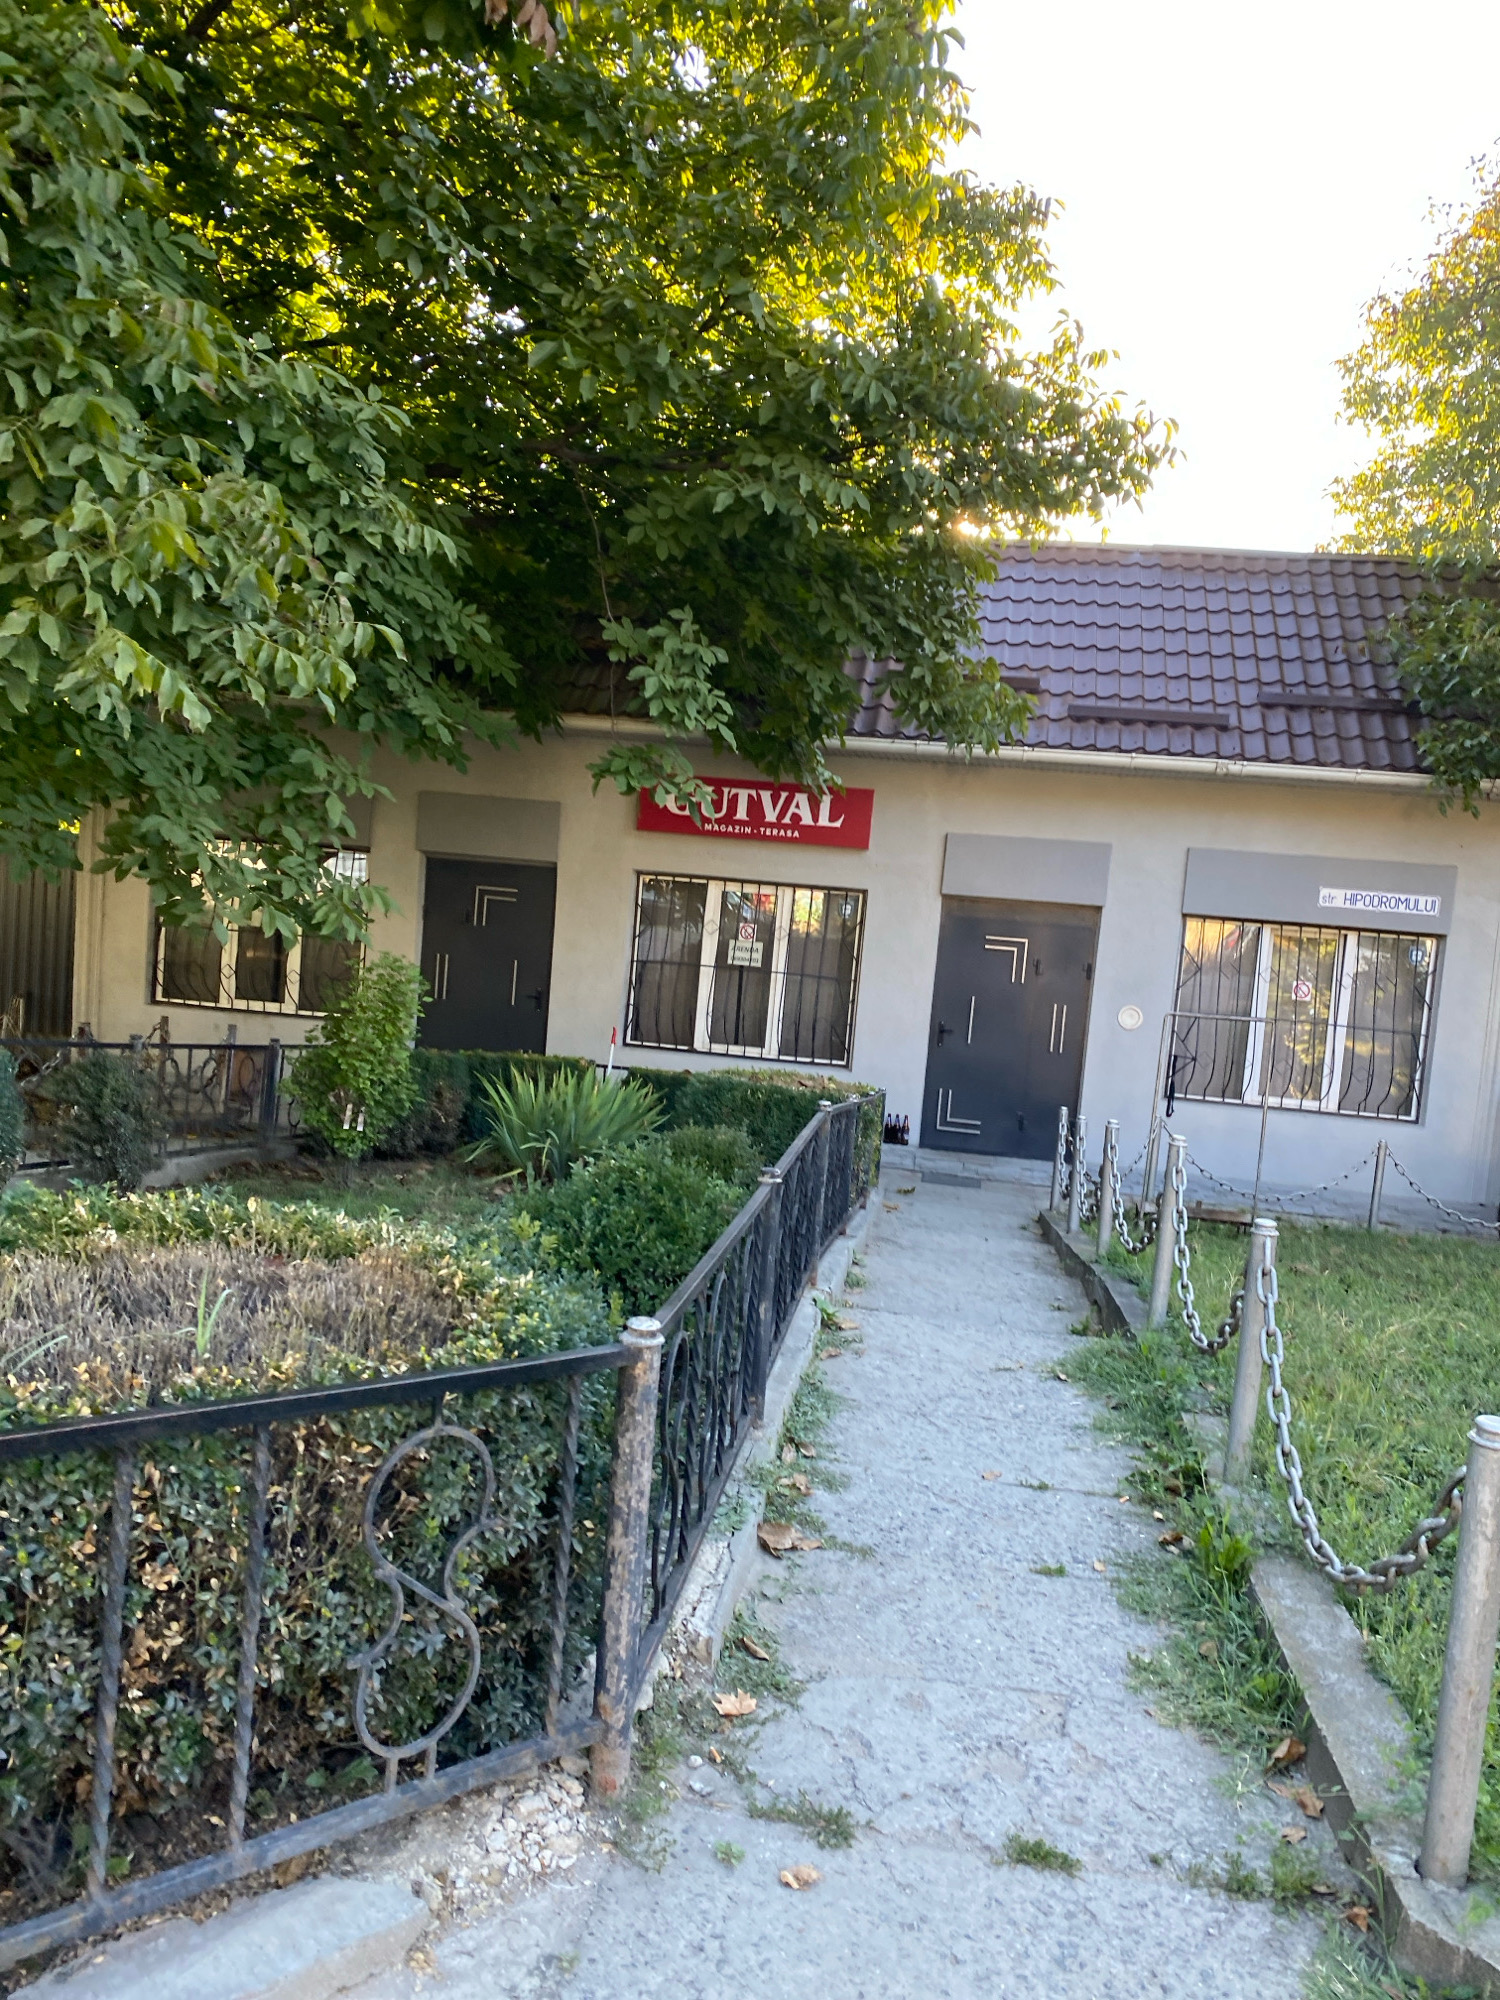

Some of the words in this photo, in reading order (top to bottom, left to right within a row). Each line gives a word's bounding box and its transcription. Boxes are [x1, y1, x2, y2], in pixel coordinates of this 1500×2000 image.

[704, 822, 752, 834] MAGAZIN
[759, 827, 800, 838] TERASA
[1343, 892, 1437, 913] HIPODROMULUI
